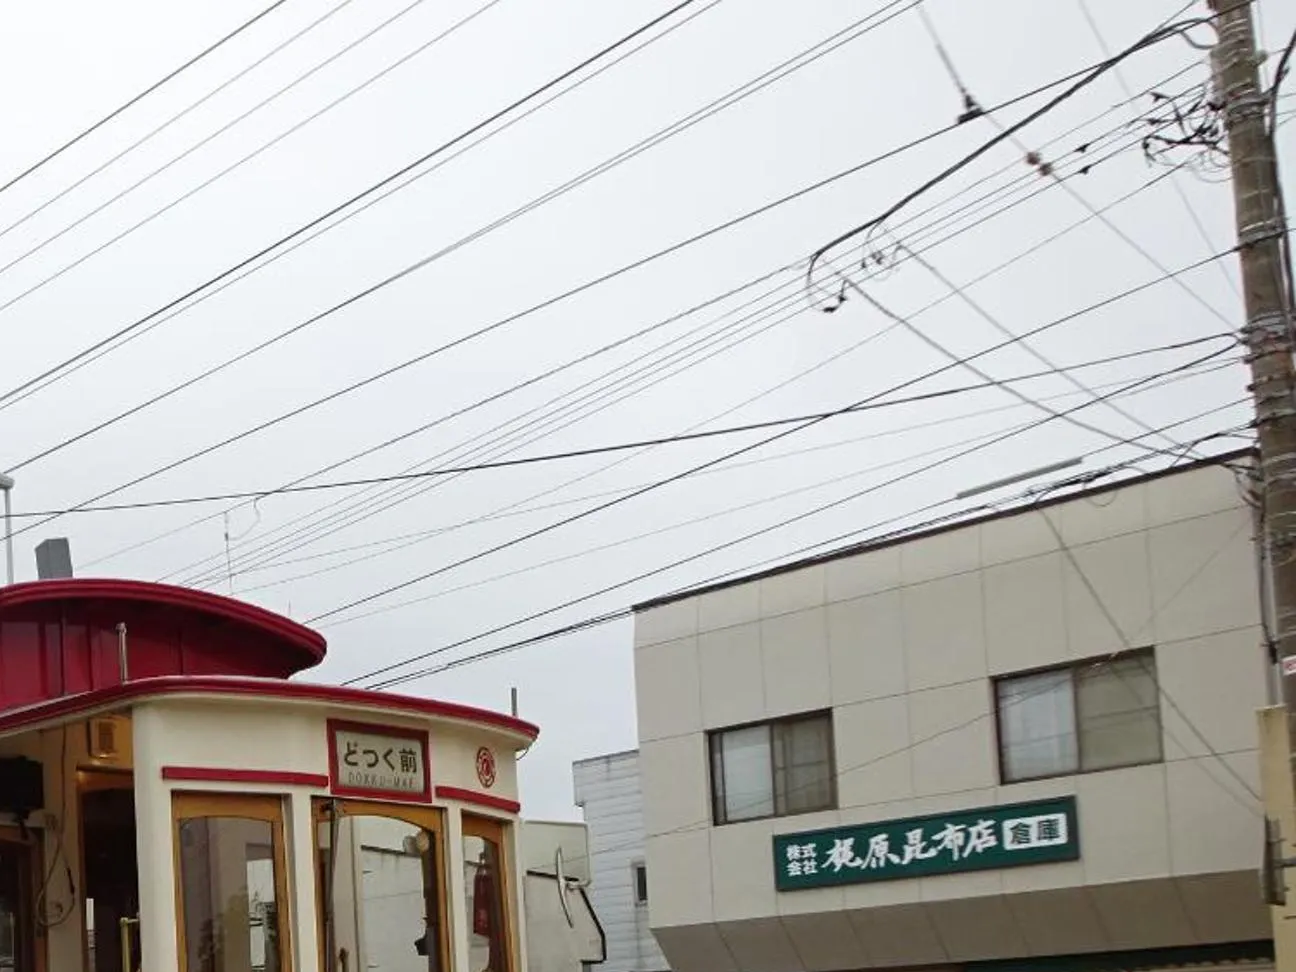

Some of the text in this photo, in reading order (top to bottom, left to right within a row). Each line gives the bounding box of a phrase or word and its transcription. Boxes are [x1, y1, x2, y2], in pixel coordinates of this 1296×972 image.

[344, 742, 417, 773] どつく前
[1010, 819, 1061, 844] 倉庫
